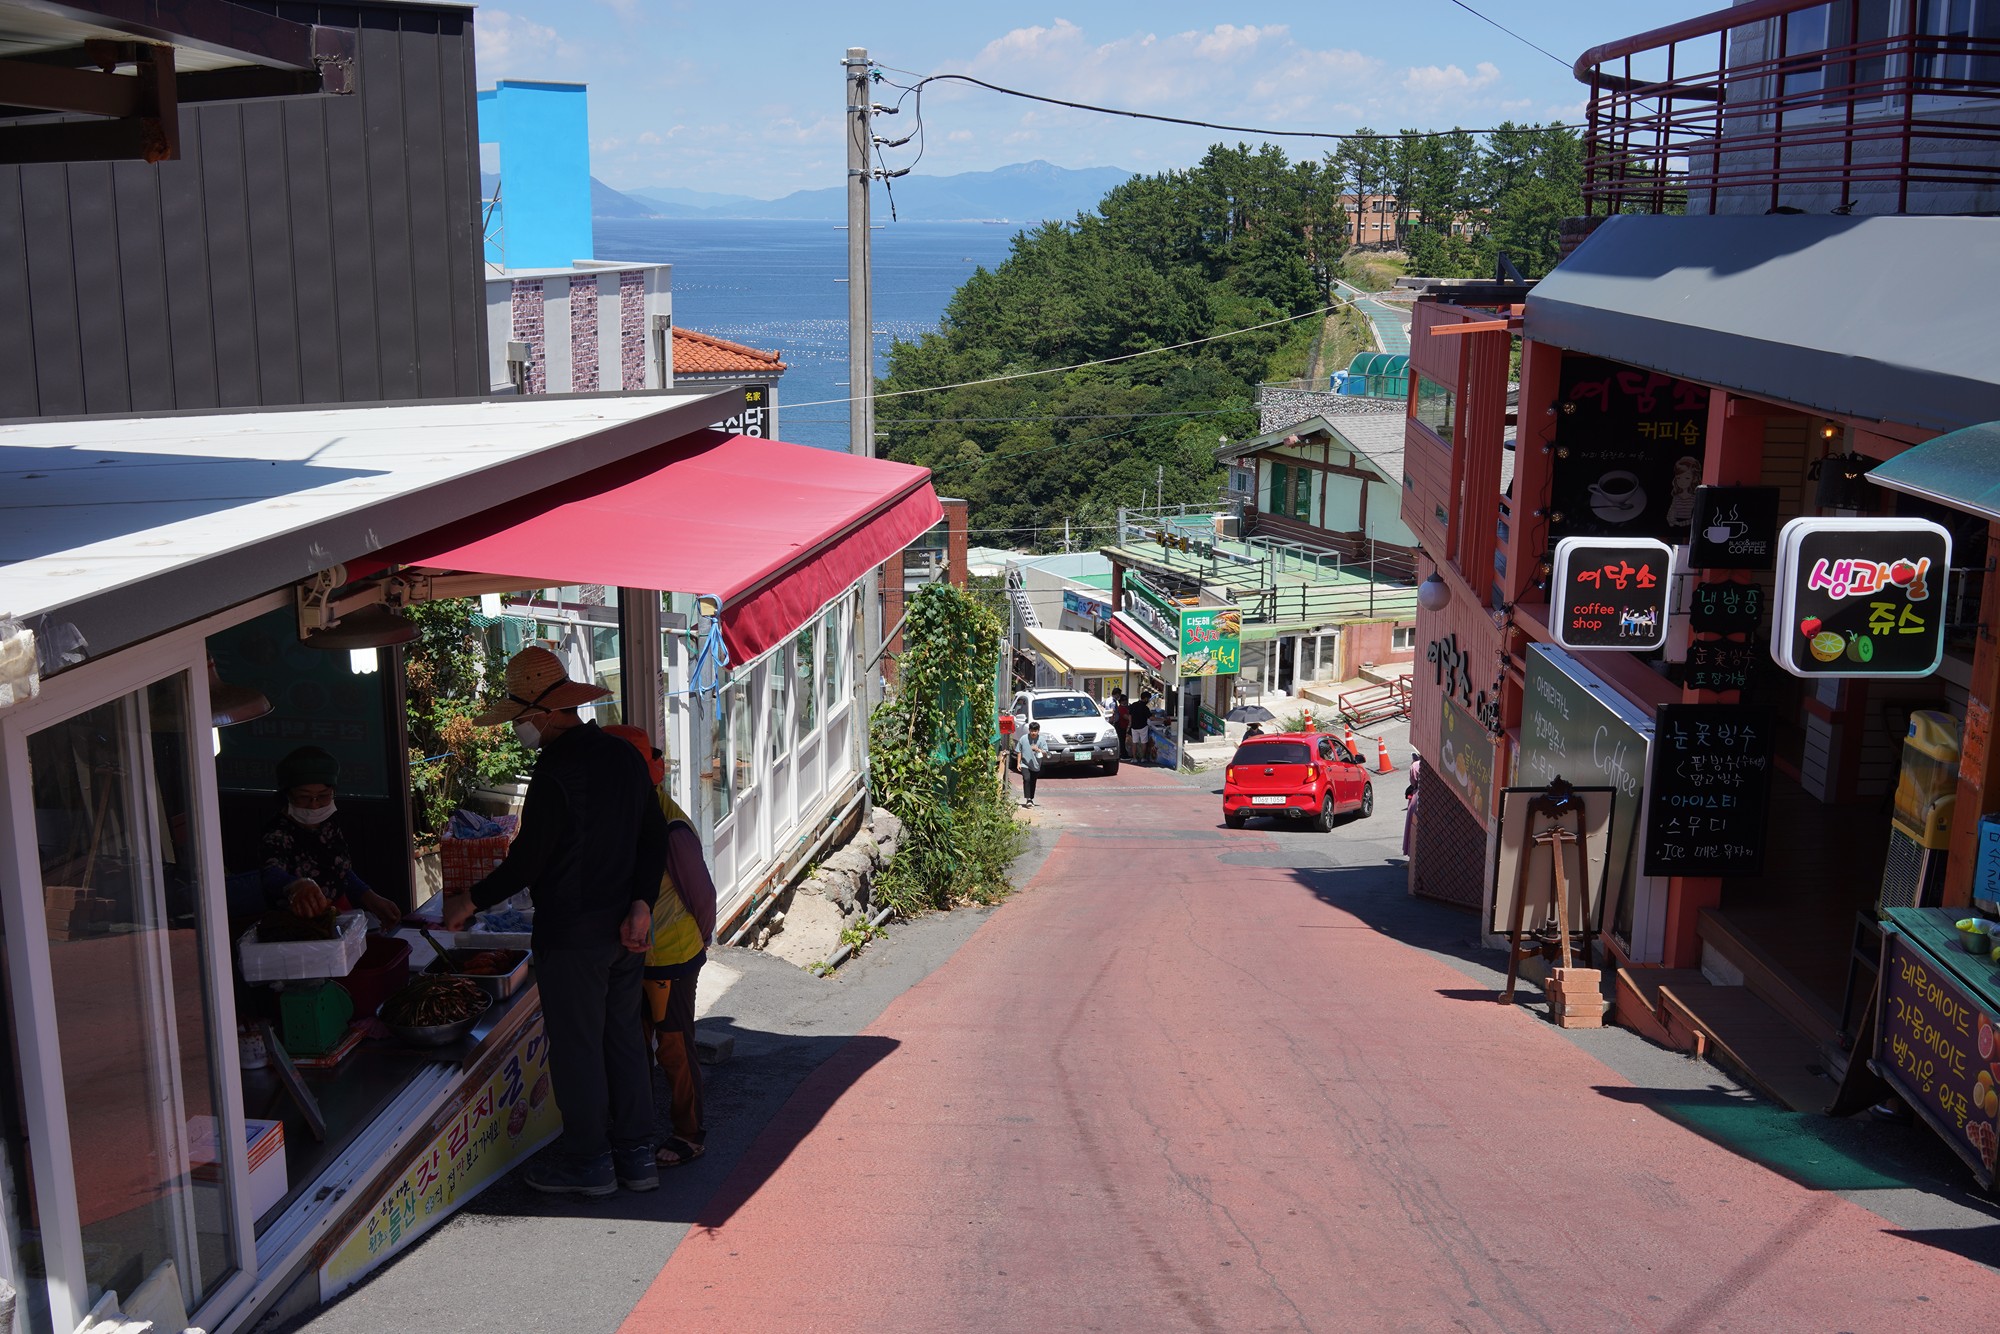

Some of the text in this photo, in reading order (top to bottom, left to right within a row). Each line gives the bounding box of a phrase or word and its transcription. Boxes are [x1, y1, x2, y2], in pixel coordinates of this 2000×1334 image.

[1637, 419, 1701, 446] 커피숍
[1728, 545, 1766, 555] COFFEE
[1576, 560, 1658, 591] 여담소
[1808, 558, 1932, 601] 생과일
[1078, 600, 1101, 615] GS25
[1186, 616, 1210, 626] 다도해
[1573, 603, 1615, 616] coffee
[1868, 601, 1926, 637] 쥬스
[1573, 616, 1602, 632] shop
[1210, 645, 1236, 669] 파전
[1536, 675, 1570, 721] 아메리카노
[1534, 709, 1568, 759] 생과일쥬스
[1594, 725, 1636, 798] Coffee
[1670, 794, 1737, 809] 아이스티
[1661, 843, 1686, 861] Ice
[1900, 955, 1971, 1039] 레몬에이드
[1896, 995, 1967, 1081] 자몽에이드
[1892, 1035, 1969, 1130] 벨지움 와플
[388, 1191, 416, 1247] 돌산
